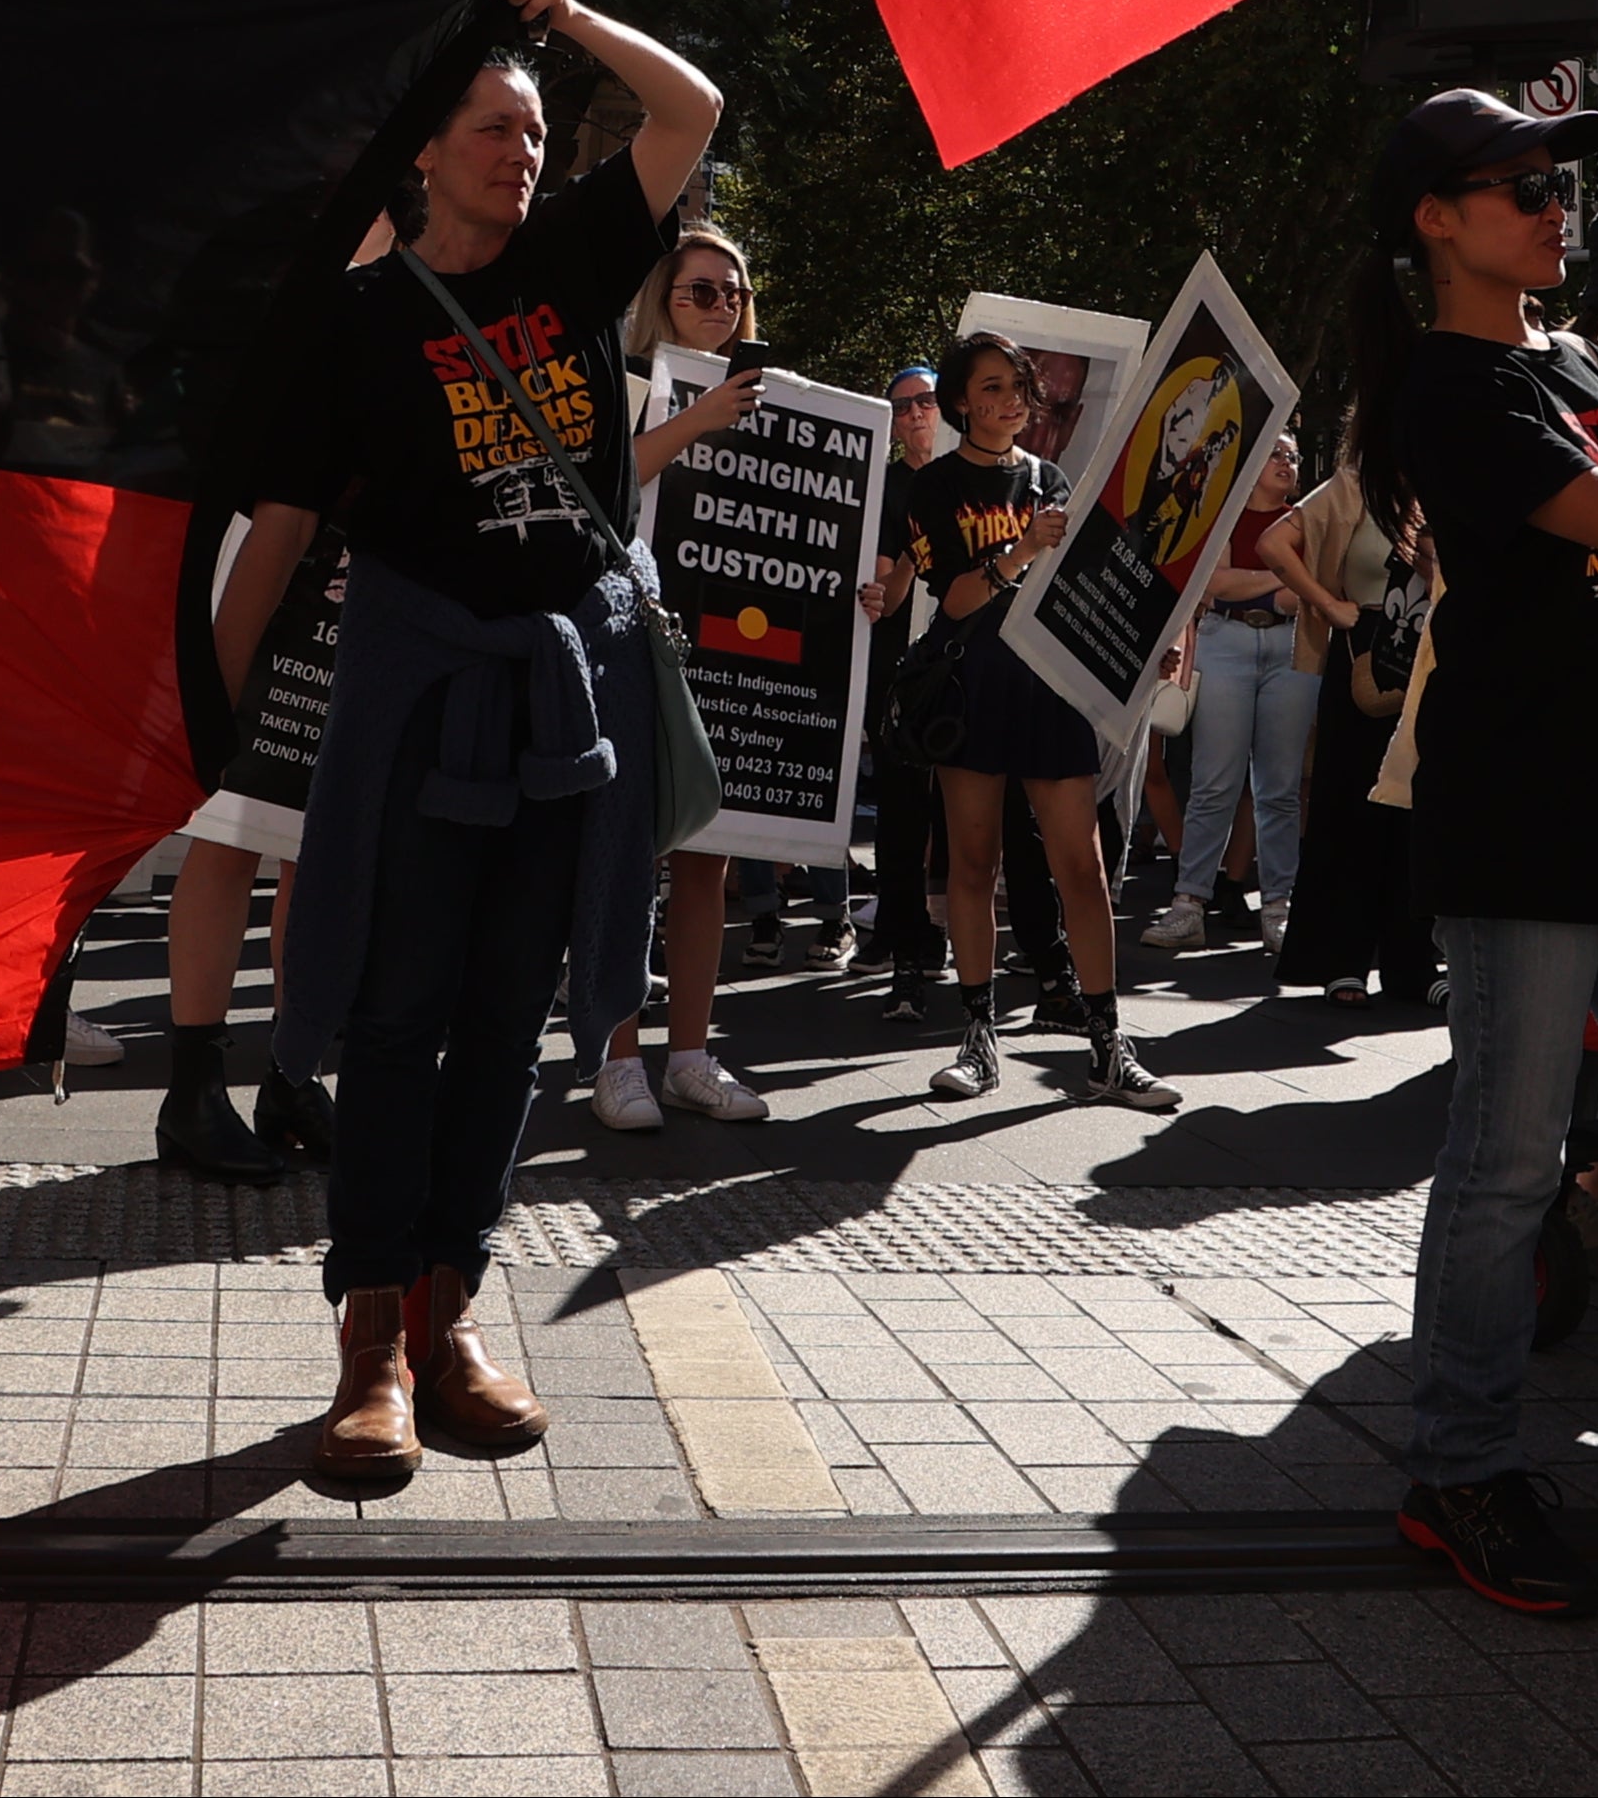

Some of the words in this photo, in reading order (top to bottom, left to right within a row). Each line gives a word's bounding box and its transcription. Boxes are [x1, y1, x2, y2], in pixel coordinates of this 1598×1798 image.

[443, 354, 589, 417] BLCK
[453, 389, 595, 450] DEAHS
[686, 391, 780, 439] AT
[785, 417, 817, 450] IS
[823, 427, 868, 462] AN
[457, 450, 487, 474] IN
[670, 442, 862, 508] ABORIGINAL
[693, 491, 799, 541] DEATH
[806, 517, 840, 551] IN
[676, 538, 843, 598] CUSTODY?
[1110, 535, 1154, 589] 28.09.1983
[680, 665, 733, 686] ontact:
[737, 672, 818, 700] Indigenous
[259, 711, 302, 736] TAKEN
[303, 724, 322, 741] TO
[752, 702, 838, 730] Association
[252, 738, 300, 762] FOUND
[729, 727, 785, 752] Sydney
[735, 755, 772, 775] 0423
[776, 760, 803, 779] 732
[807, 765, 835, 783] 094
[724, 781, 762, 801] 0403
[765, 787, 793, 806] 037
[797, 790, 825, 810] 376
